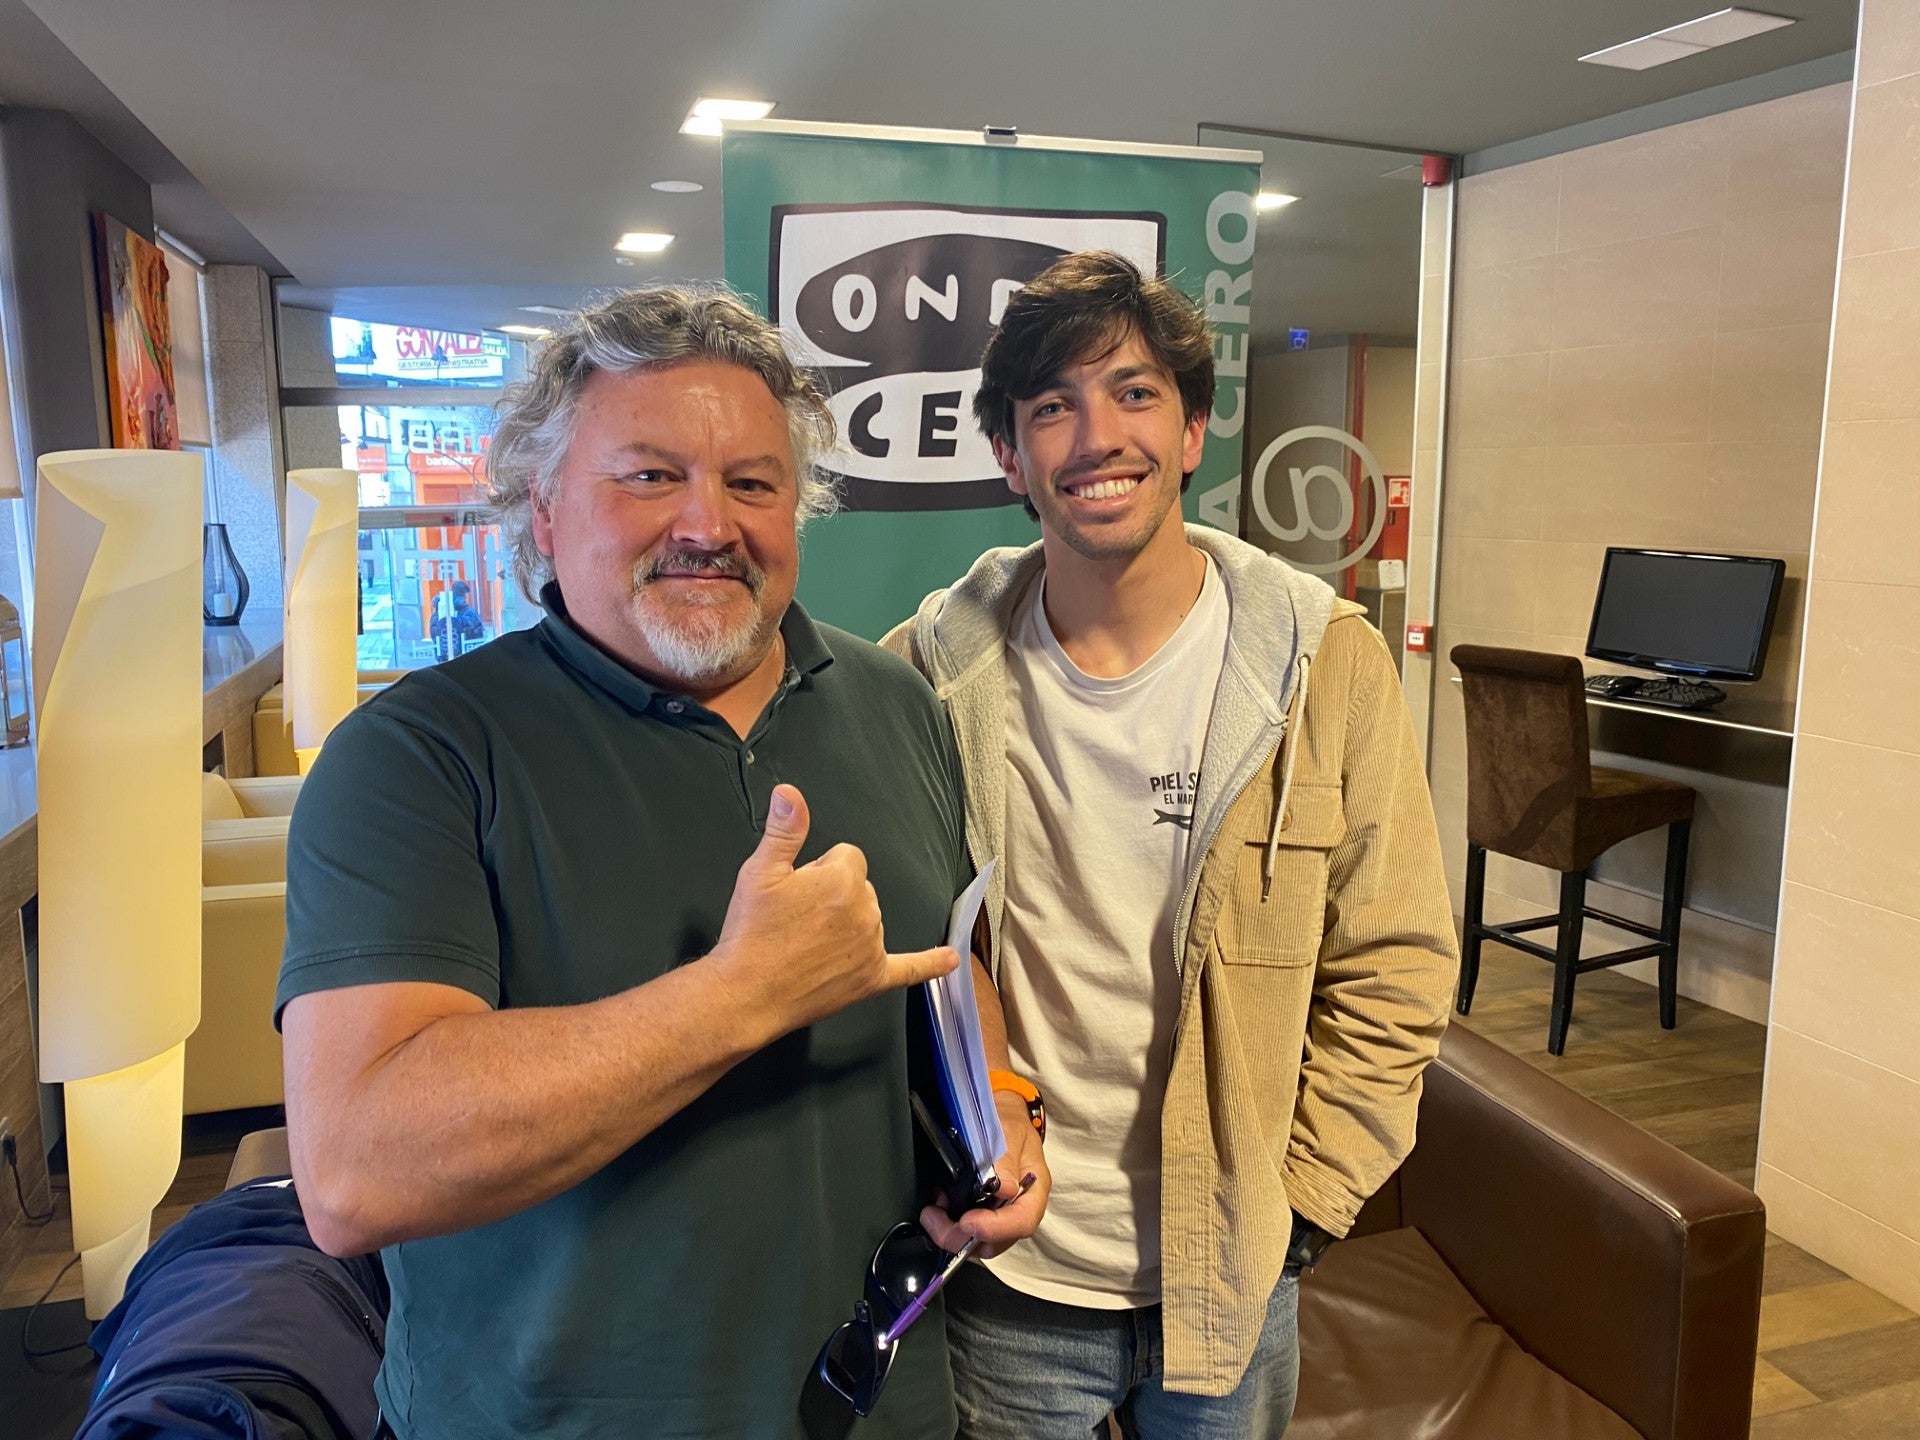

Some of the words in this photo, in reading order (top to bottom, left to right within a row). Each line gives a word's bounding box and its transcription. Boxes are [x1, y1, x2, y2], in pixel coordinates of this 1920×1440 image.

[1206, 190, 1257, 438] CERO
[1149, 771, 1183, 792] PIEL
[1163, 793, 1175, 805] EL
